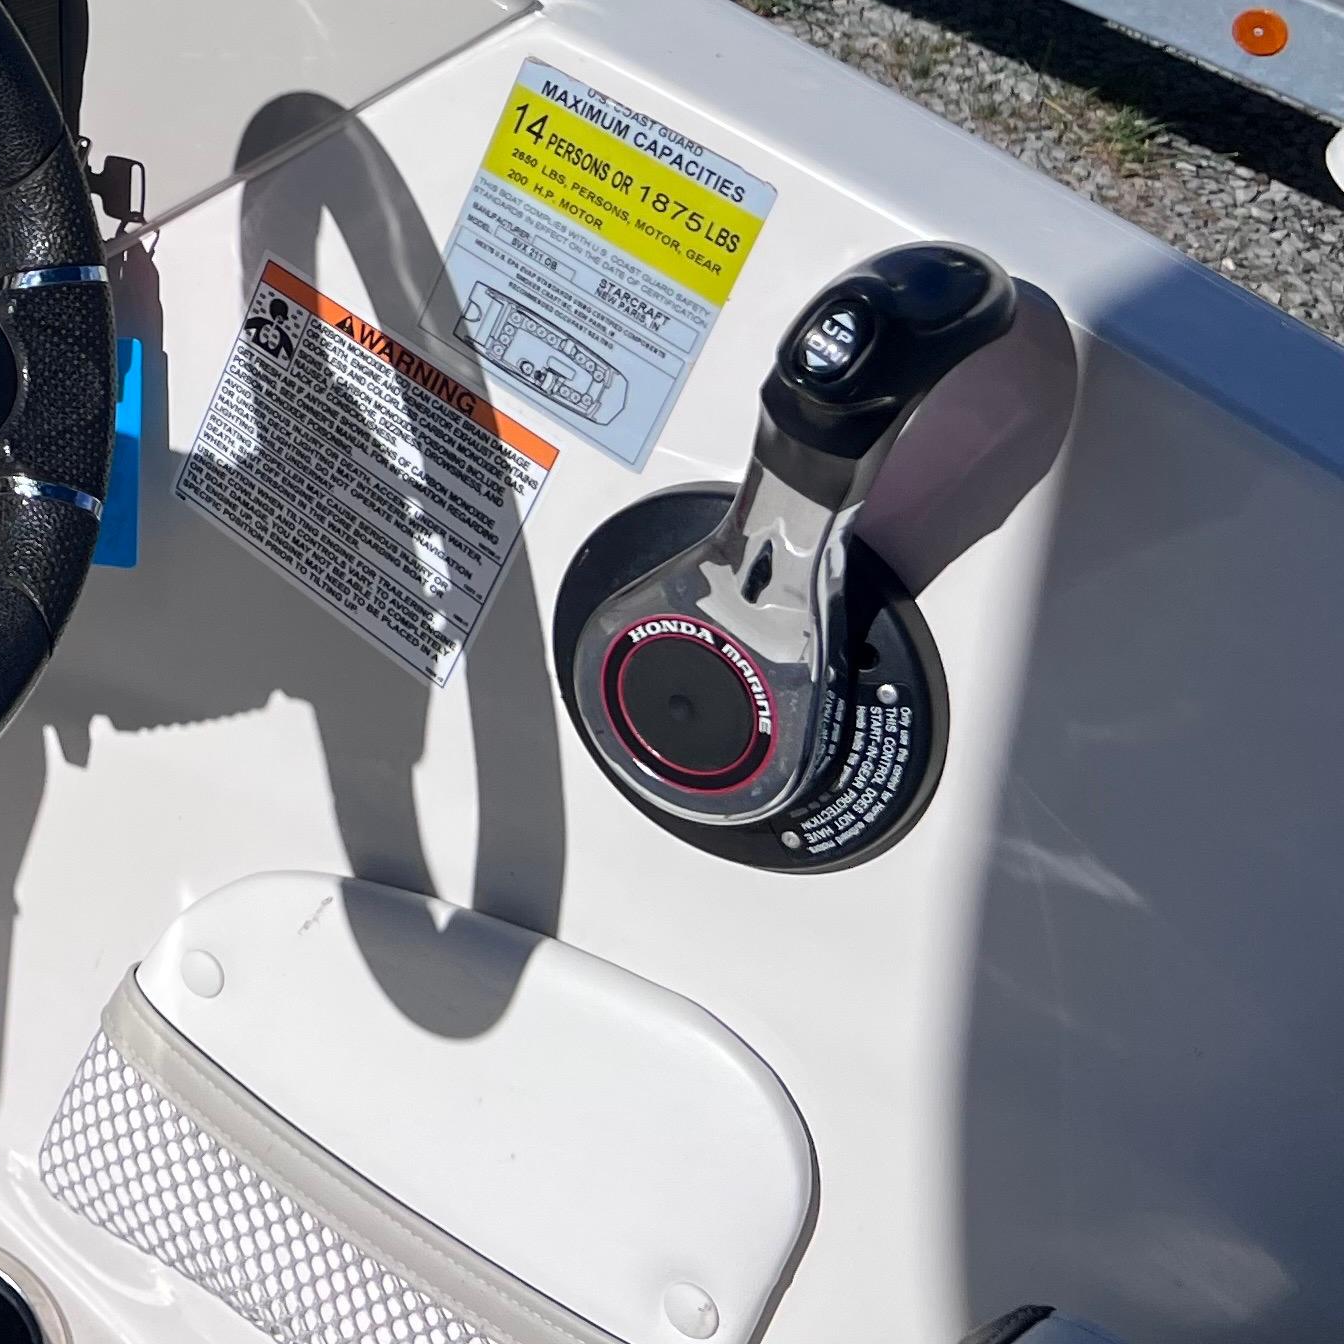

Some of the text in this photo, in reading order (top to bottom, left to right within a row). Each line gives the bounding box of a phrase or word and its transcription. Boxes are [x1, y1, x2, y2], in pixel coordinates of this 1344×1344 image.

[540, 79, 747, 204] MAXIMUM CAPACITIES
[658, 126, 704, 157] GUARD
[506, 167, 529, 187] 200
[558, 197, 604, 230] MOTOR
[507, 99, 741, 254] 14 PERSONS OR 1875 LBS
[609, 254, 641, 277] COAST
[640, 272, 675, 297] GUARD
[674, 292, 711, 318] SAFETY
[684, 247, 723, 275] GEAR
[593, 287, 617, 306] NEW
[649, 319, 661, 332] IN
[597, 277, 671, 327] STARCRAFT
[822, 319, 853, 344] UP
[310, 318, 530, 471] CARBON CAN CAUSE BRAIN DAMAGE
[355, 322, 478, 415] WARNING
[305, 327, 539, 490] OR AND EXHAUST CONTAINS
[347, 368, 456, 447] AND CARBON
[220, 384, 432, 538] OR MAY WITH
[397, 456, 411, 470] OF
[410, 465, 448, 496] CARBON
[465, 463, 505, 495] INCLUDE
[216, 457, 255, 490] CAUTION
[256, 487, 284, 511] WHEN
[355, 560, 376, 579] FOR
[253, 445, 449, 590] PROPELLER MAY CAUSE OR
[308, 506, 326, 524] THE
[324, 447, 447, 538] OR UNDER
[329, 473, 349, 491] NOT
[349, 487, 393, 522] OPERATE
[369, 449, 499, 545] FOR REGARDING
[483, 488, 505, 508] AND
[189, 460, 203, 475] OR
[204, 471, 229, 493] BOAT
[270, 520, 290, 539] YOU
[290, 535, 311, 555] MAY
[311, 550, 332, 570] NOT
[331, 566, 346, 581] BE
[345, 576, 371, 599] ABLE
[372, 596, 386, 610] TO
[386, 606, 450, 657] COMPLETELY
[275, 513, 296, 532] AND
[295, 527, 347, 569] CONTROLS
[374, 586, 389, 601] TO
[295, 561, 307, 575] TO
[401, 564, 428, 587] BOAT
[429, 583, 444, 598] OR
[253, 519, 268, 534] OR
[304, 557, 324, 576] MAY
[324, 572, 351, 596] NEED
[351, 592, 365, 607] TO
[365, 603, 380, 618] BE
[380, 614, 420, 648] PLACED
[419, 643, 431, 656] IN
[431, 651, 440, 663] A
[628, 620, 715, 644] HONDA
[721, 644, 771, 735] MARINE
[852, 706, 883, 790] START-IN-GEAR
[884, 707, 897, 733] THIS
[870, 736, 896, 785] CONTROL
[800, 788, 857, 831] PROTECTION
[834, 811, 856, 831] NOT
[852, 787, 877, 813] DOES
[803, 825, 834, 844] HAVE
